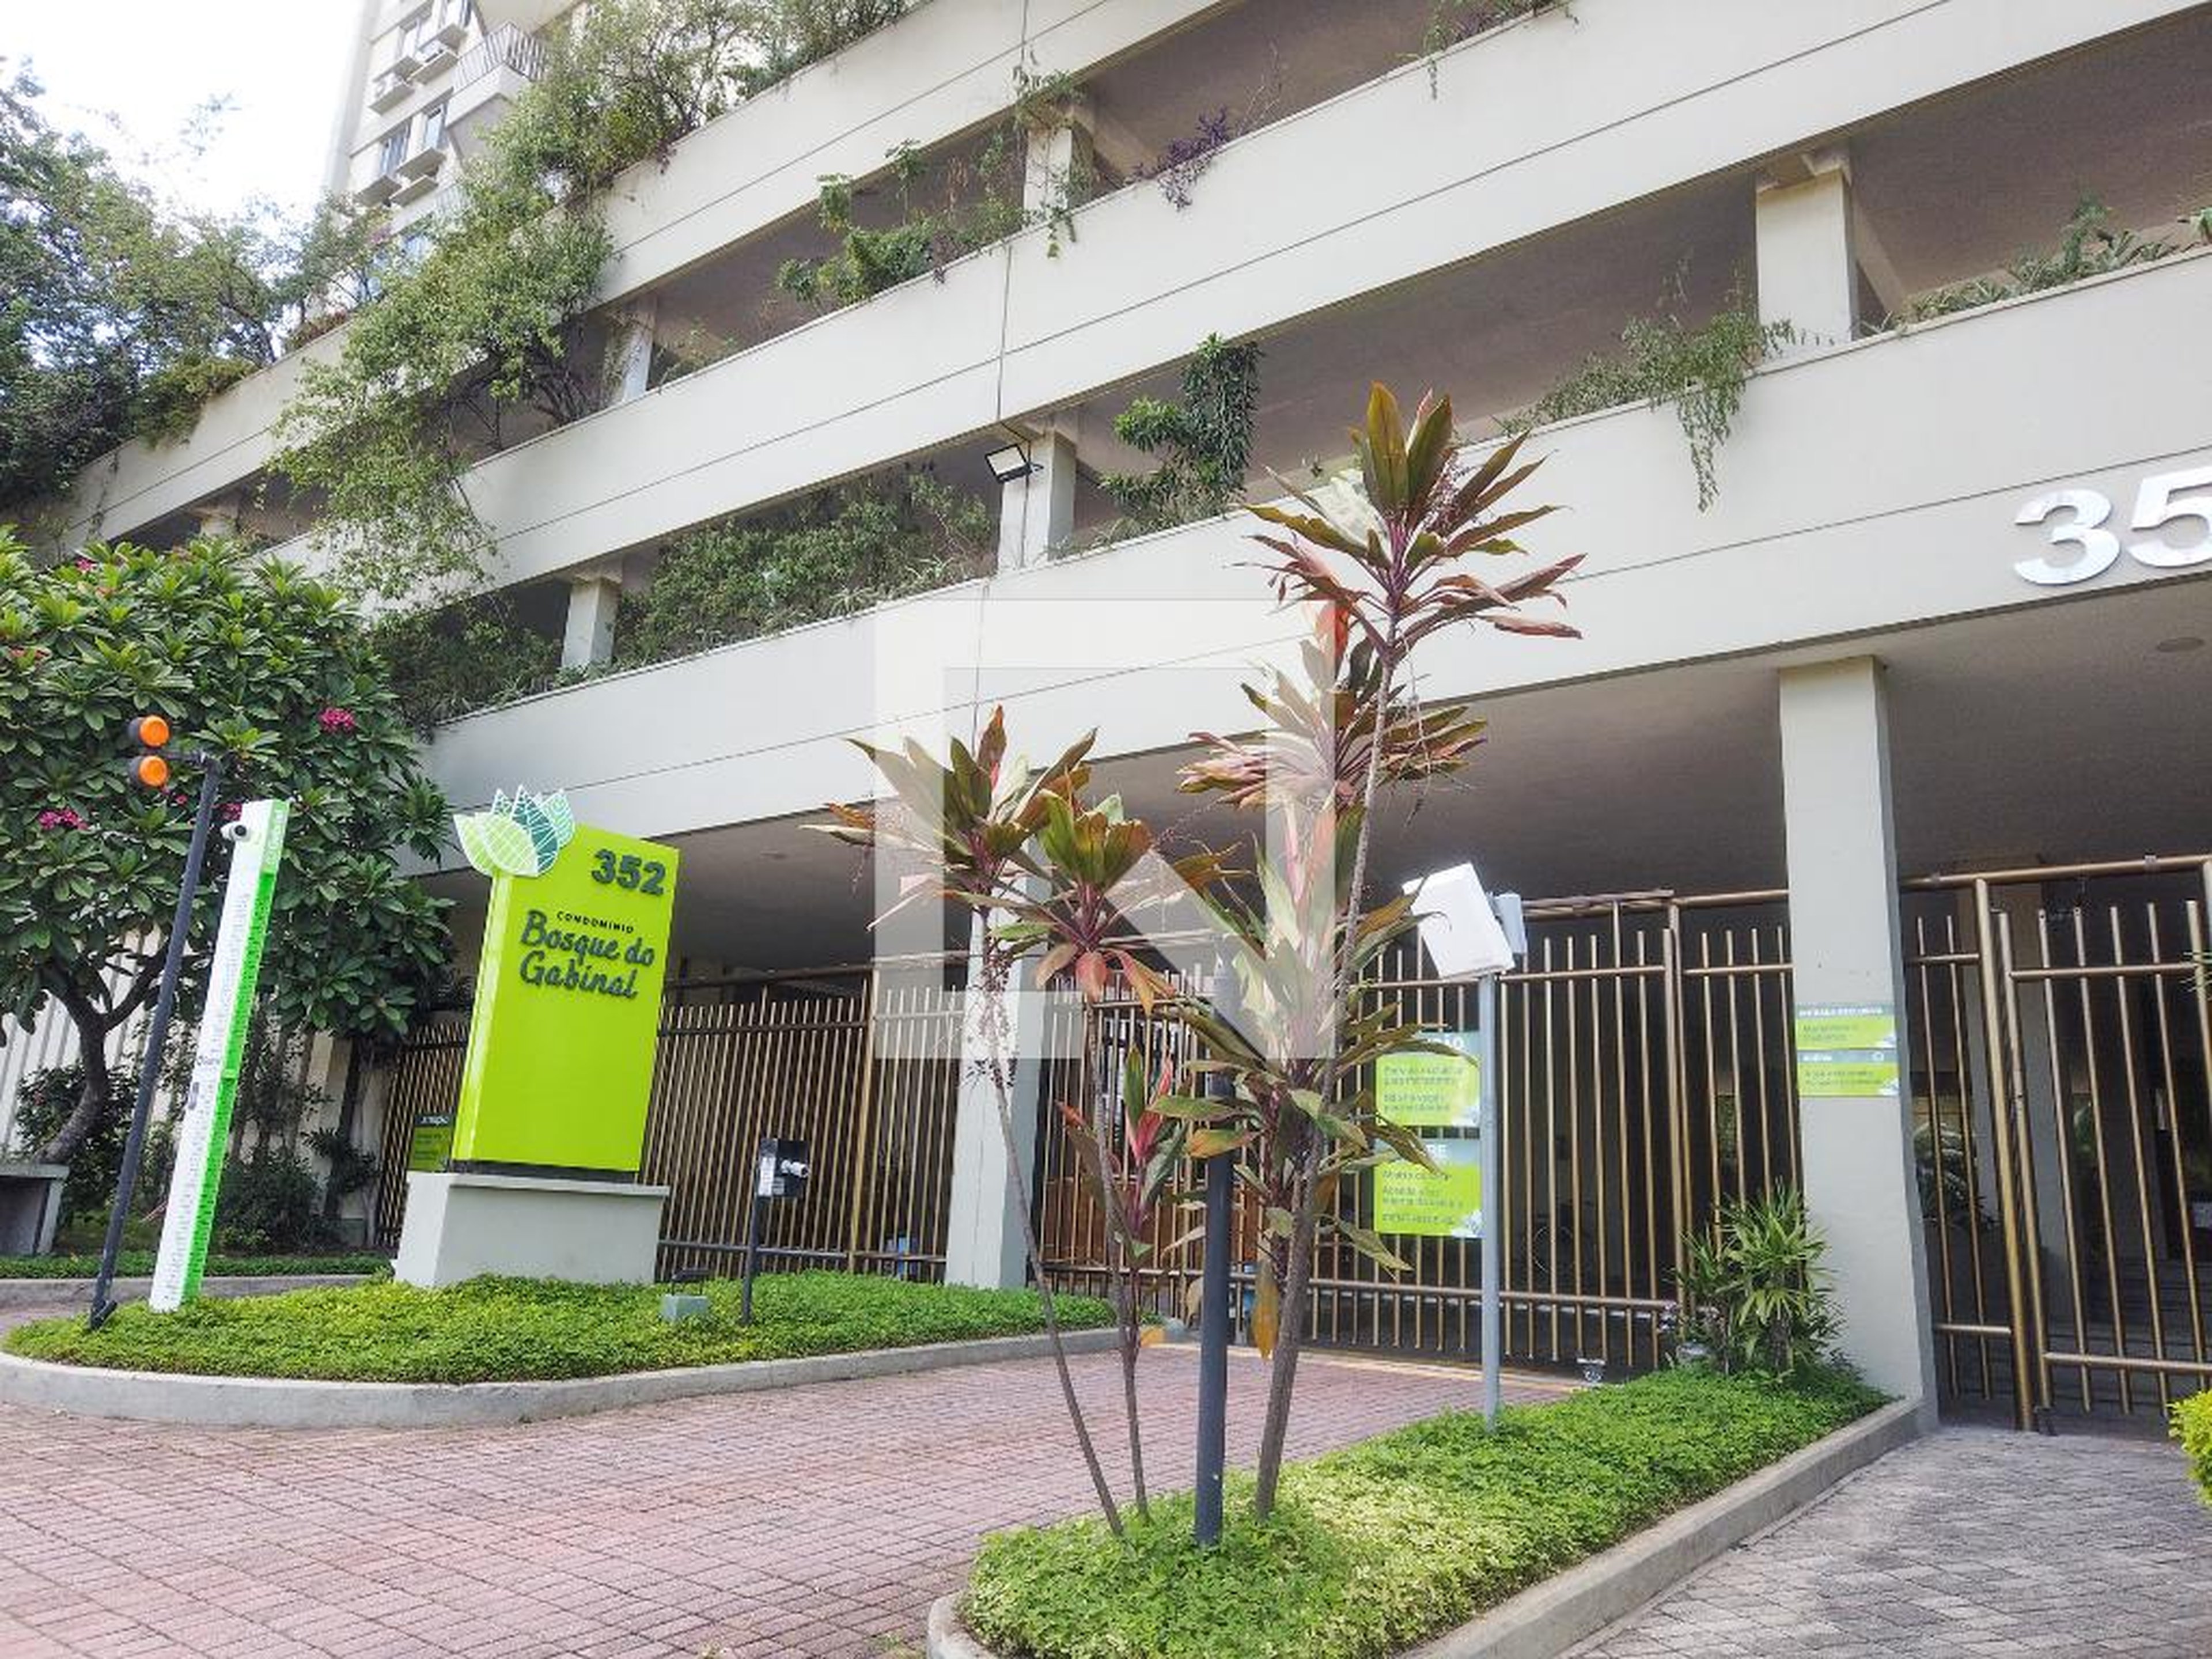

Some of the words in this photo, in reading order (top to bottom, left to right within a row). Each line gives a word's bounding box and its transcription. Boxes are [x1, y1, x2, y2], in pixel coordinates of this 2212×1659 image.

[591, 849, 666, 896] 352
[520, 909, 620, 966] Bosque
[624, 936, 656, 967] do
[520, 950, 639, 999] Gabinal
